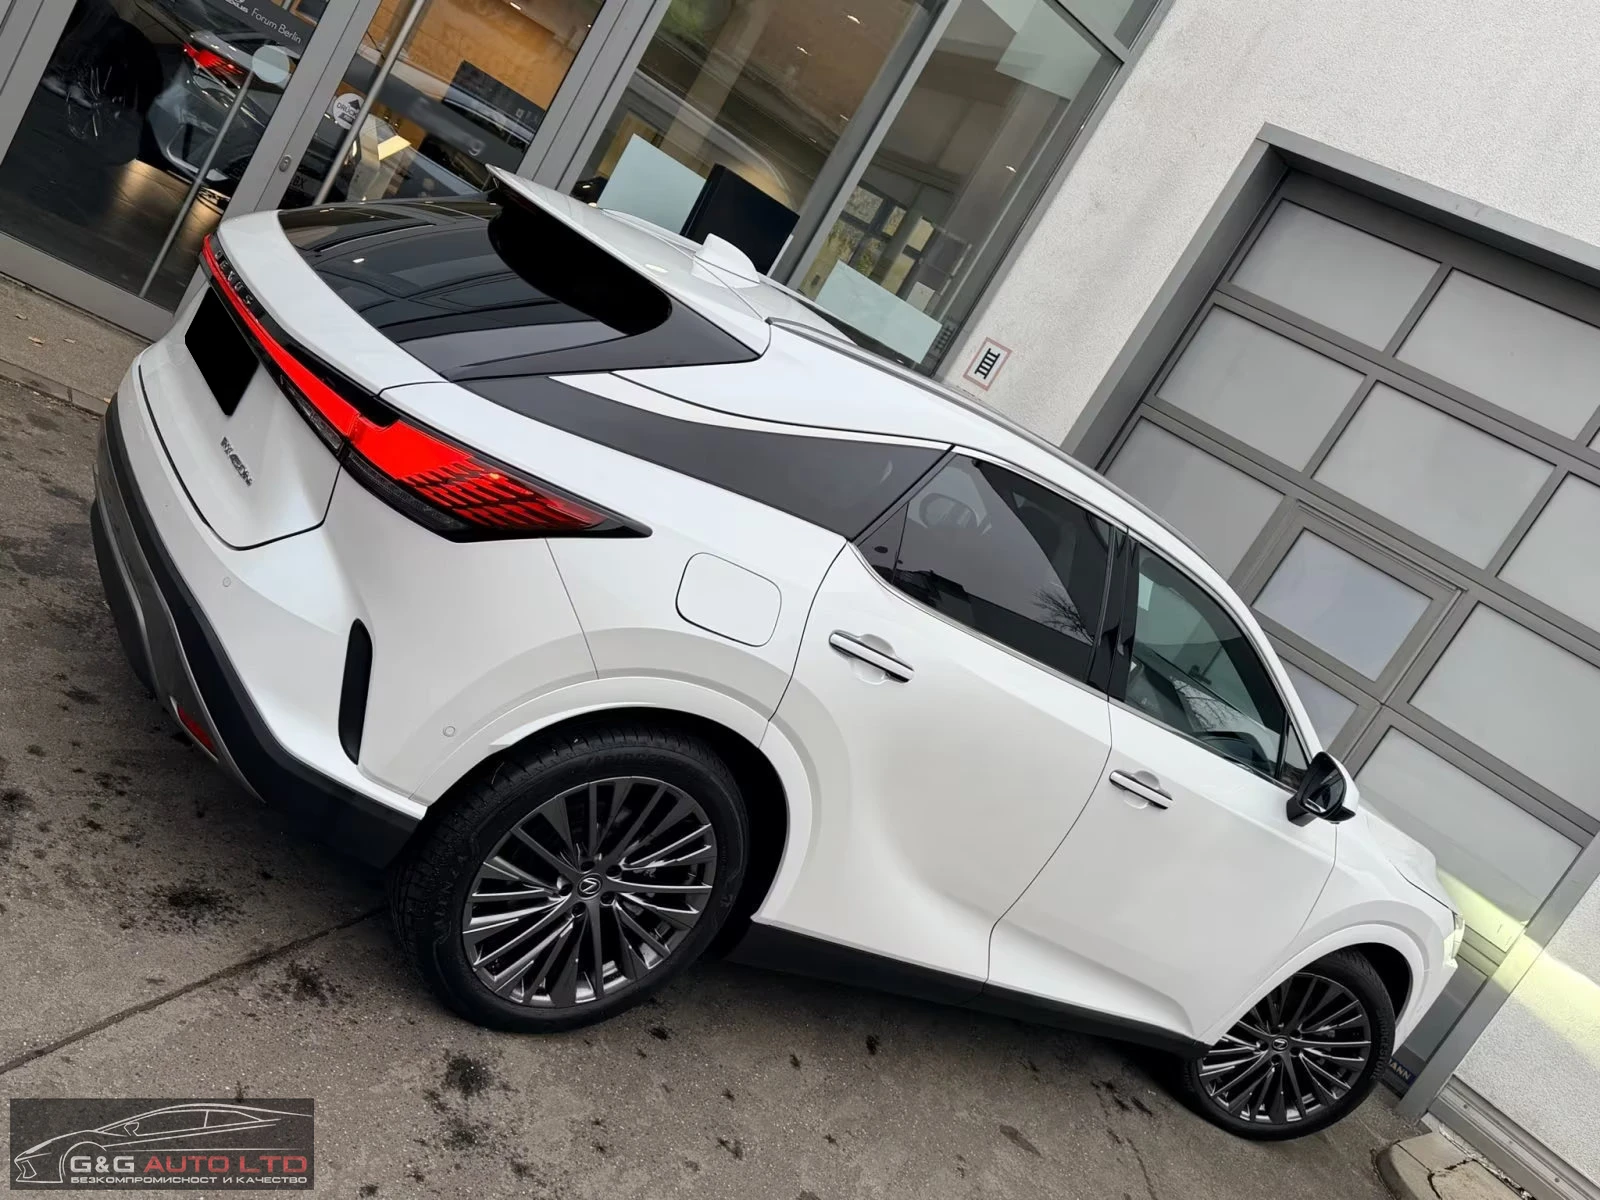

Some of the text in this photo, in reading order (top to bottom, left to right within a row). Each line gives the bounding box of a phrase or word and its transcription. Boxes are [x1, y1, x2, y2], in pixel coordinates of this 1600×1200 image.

[251, 8, 277, 29] Forum
[278, 23, 301, 44] Berlin
[337, 102, 359, 118] DRÜCK
[214, 250, 253, 304] LEXUS
